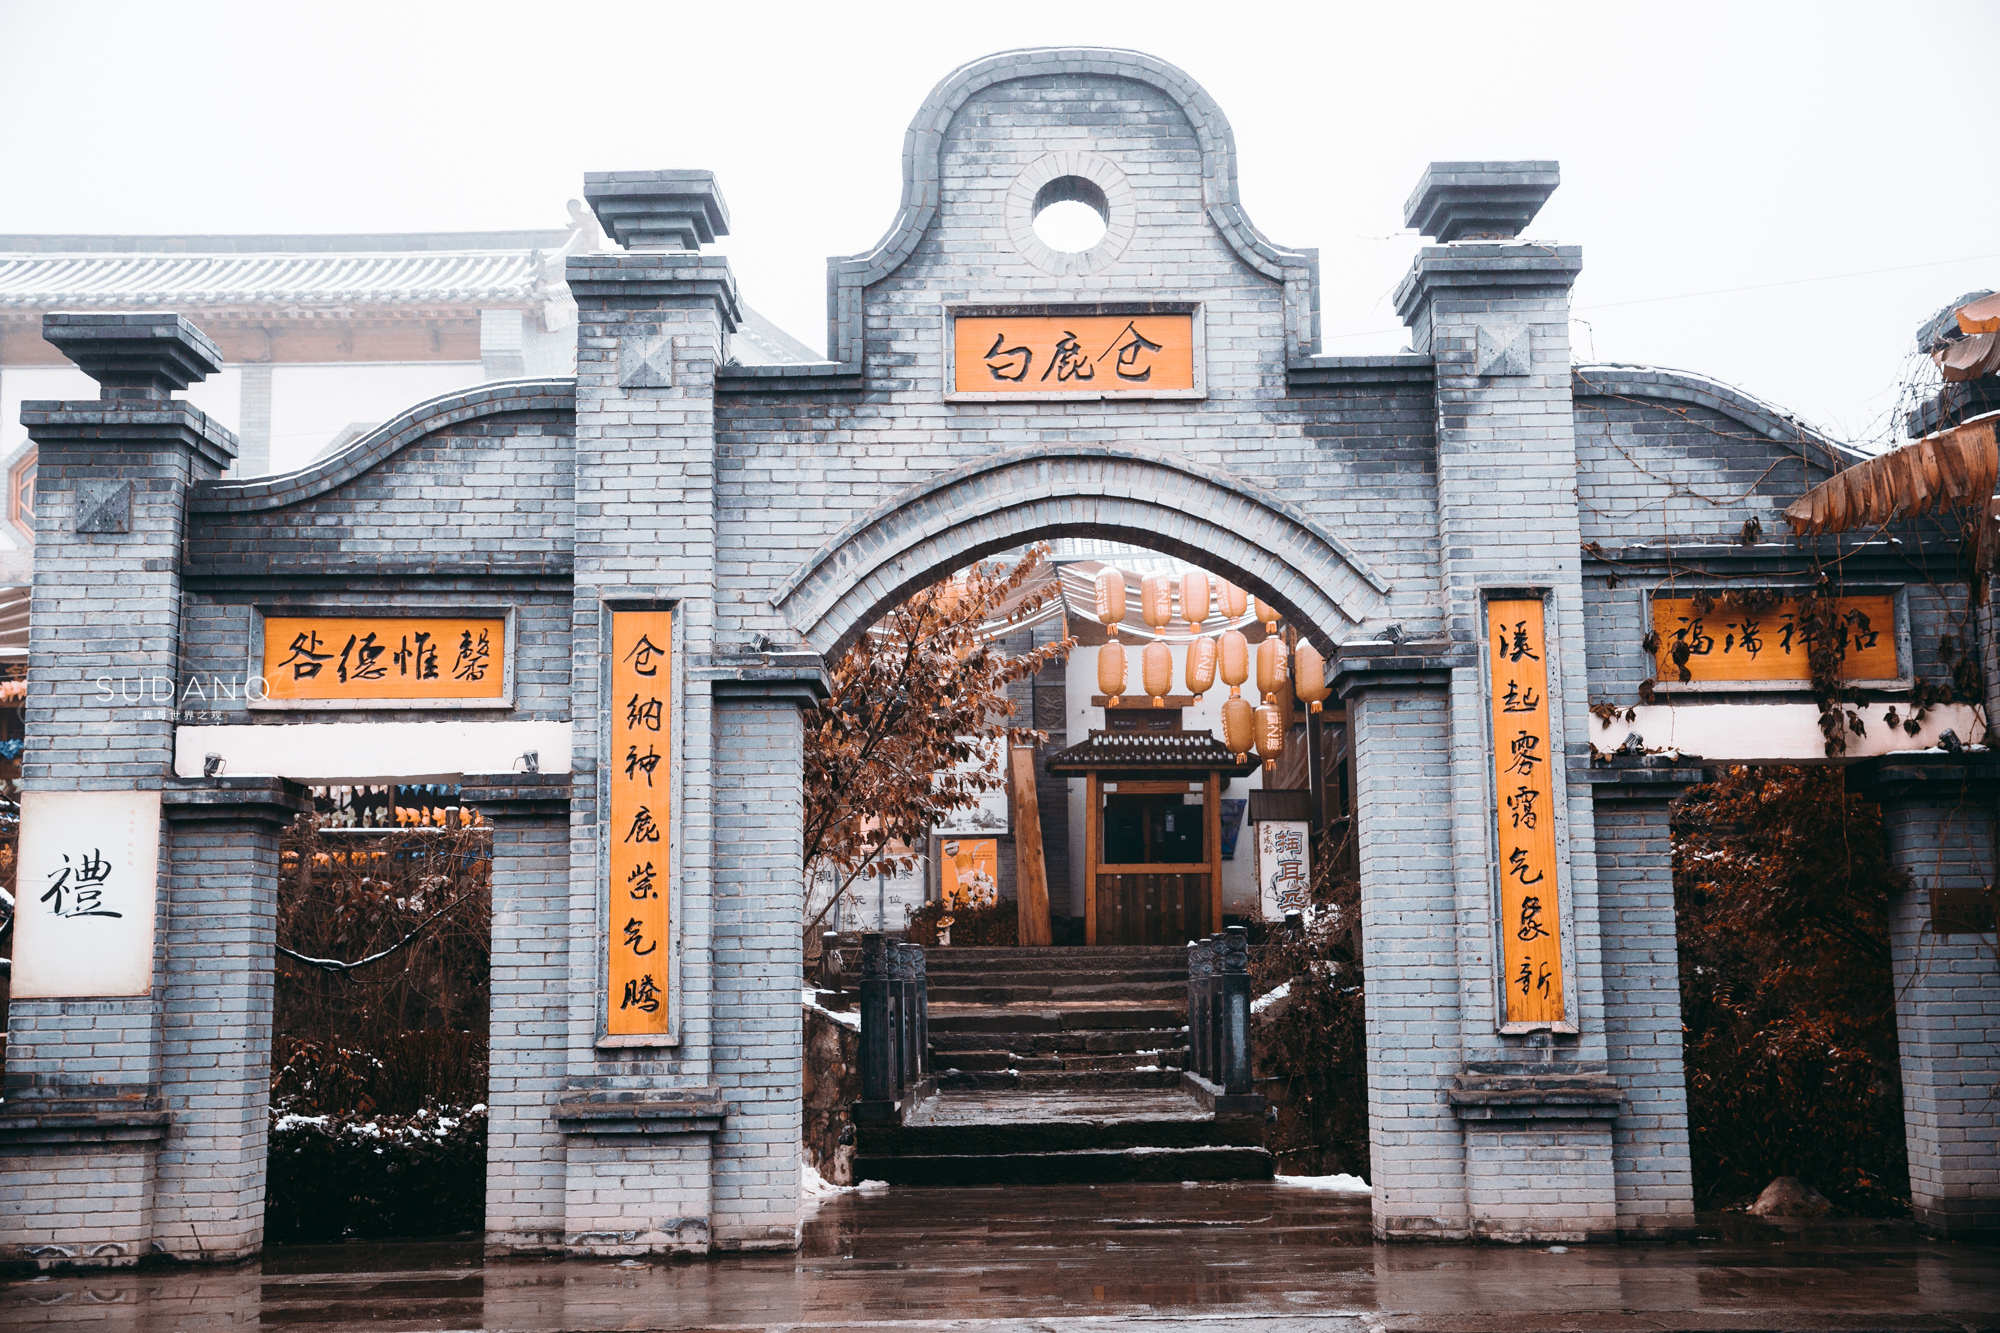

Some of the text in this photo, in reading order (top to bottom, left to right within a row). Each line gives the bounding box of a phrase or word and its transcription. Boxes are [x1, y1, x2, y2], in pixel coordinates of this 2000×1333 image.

[983, 320, 1163, 383] 白鹿仓
[1266, 712, 1280, 751] 蜀之源
[620, 634, 665, 1013] 仓纳神鹿紫气腾
[40, 848, 122, 919] 禮
[1275, 830, 1306, 913] 掏耳朵
